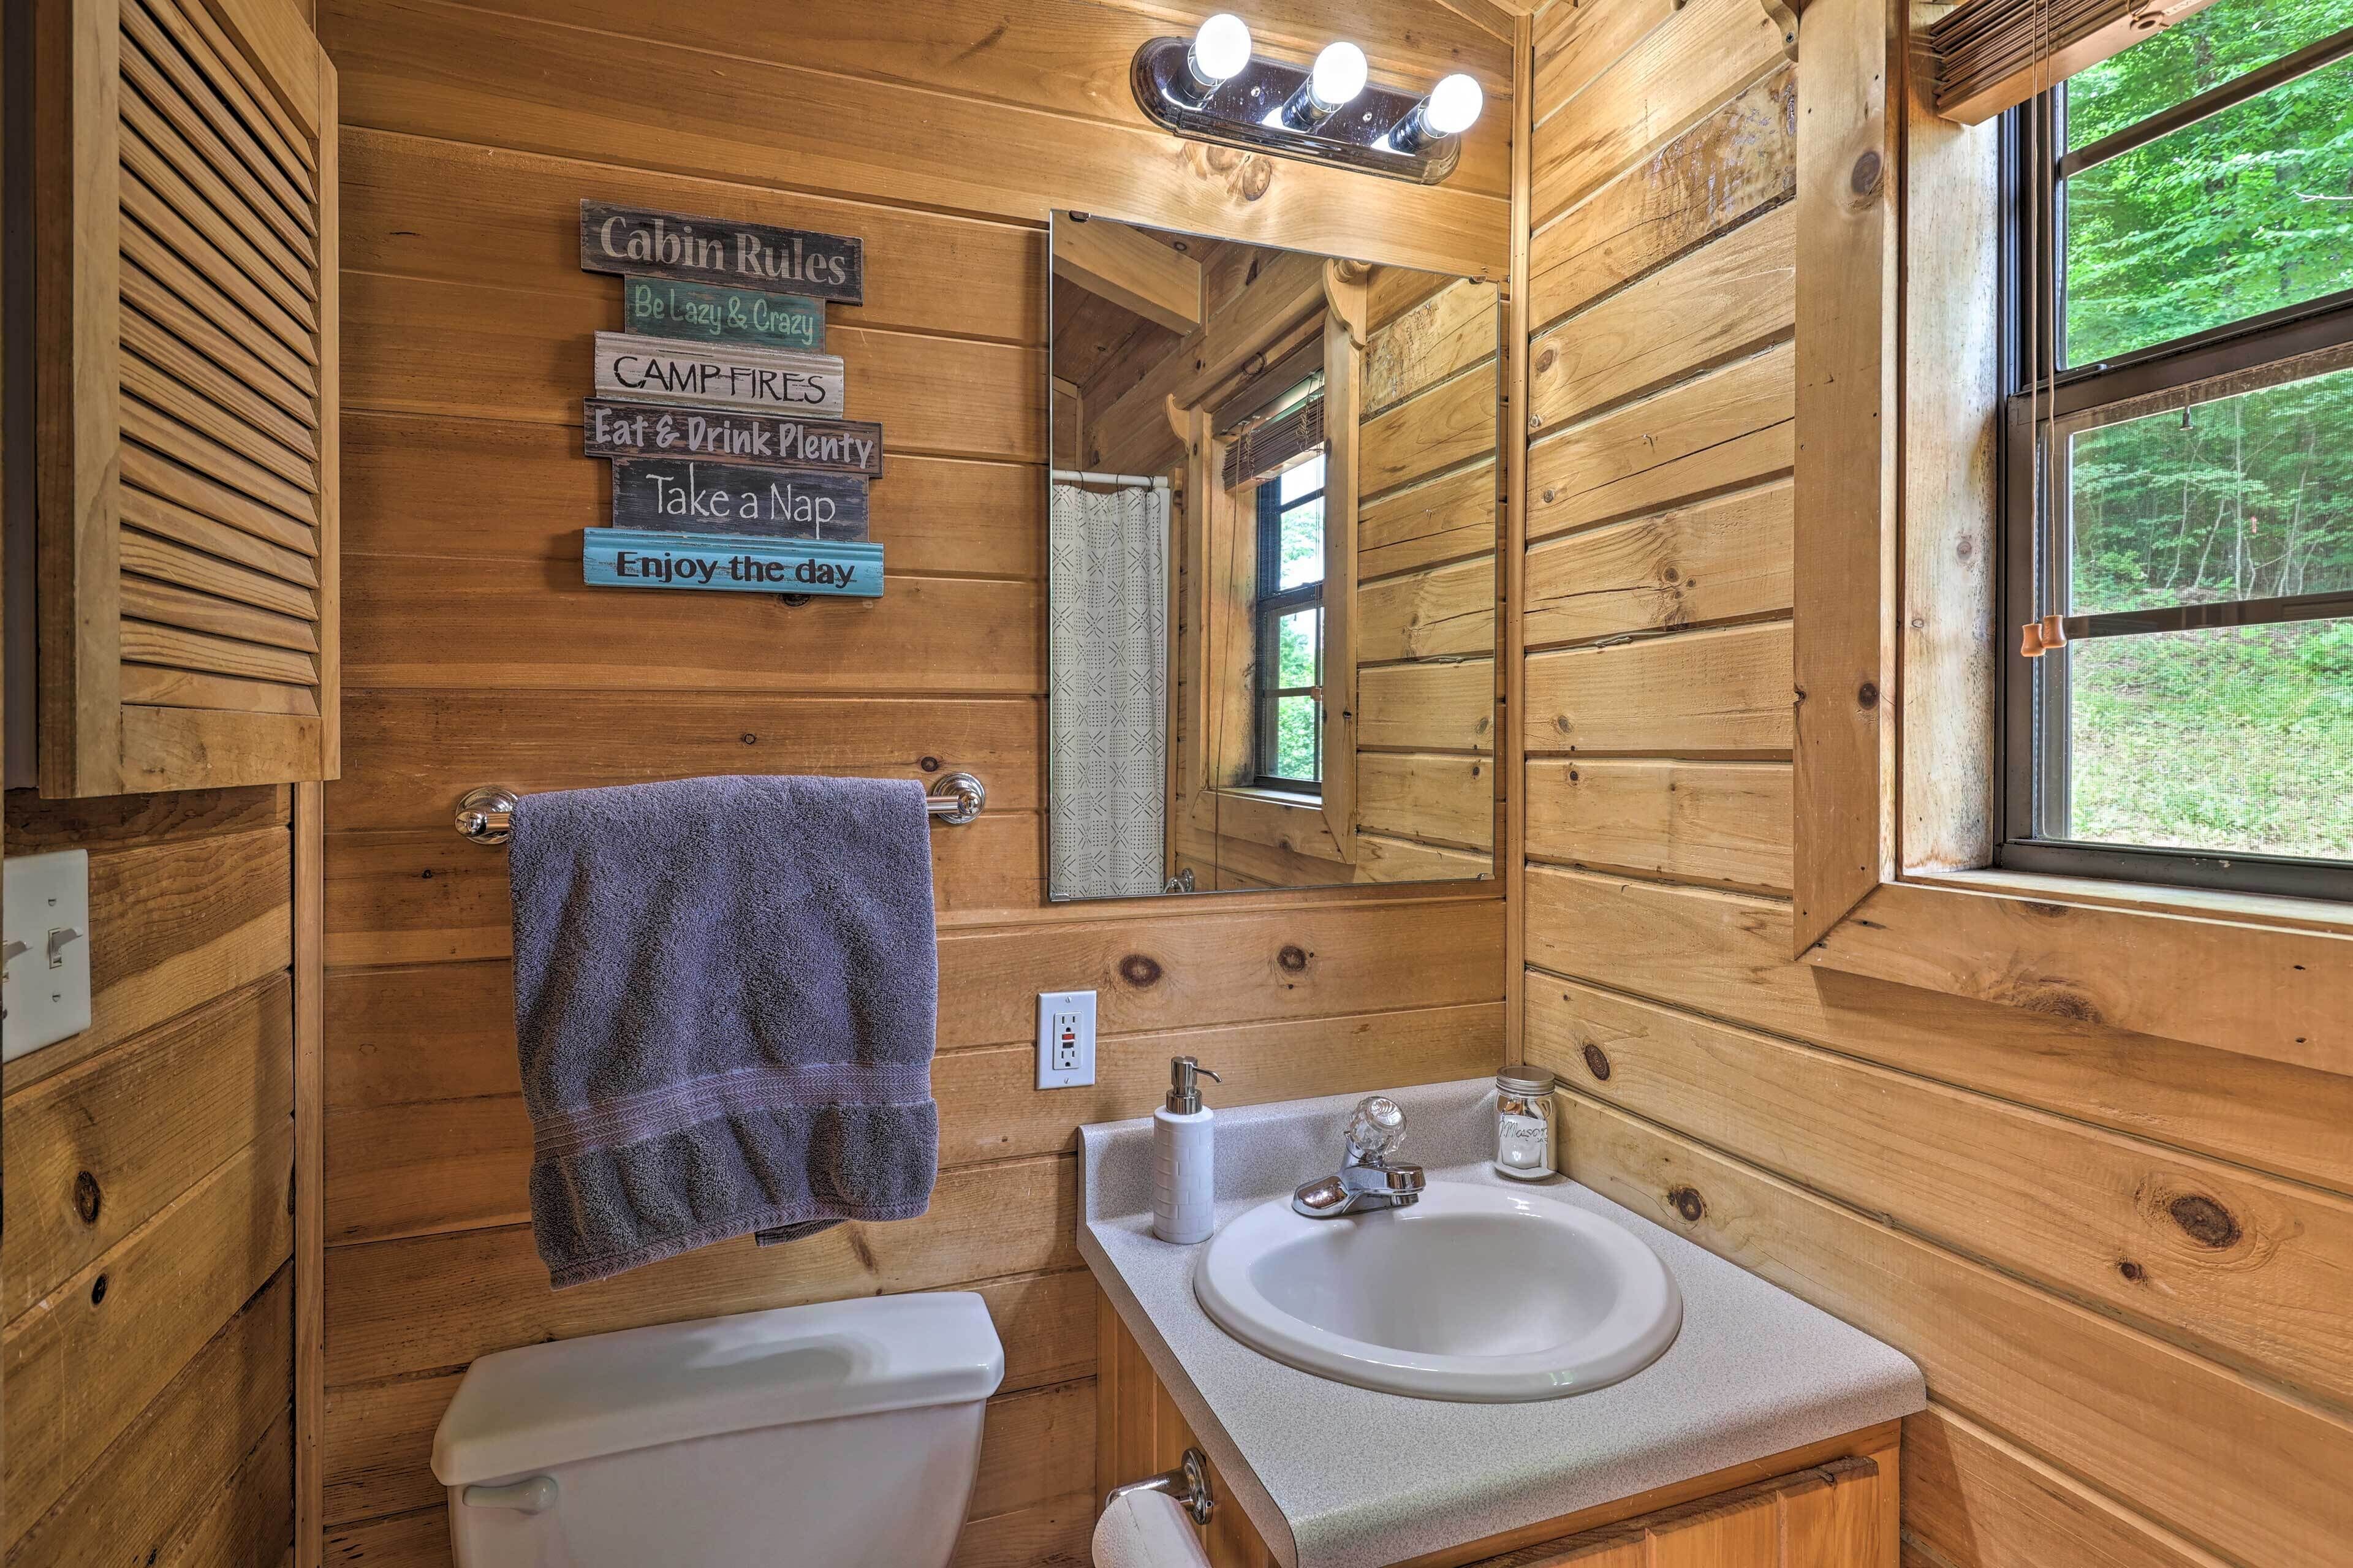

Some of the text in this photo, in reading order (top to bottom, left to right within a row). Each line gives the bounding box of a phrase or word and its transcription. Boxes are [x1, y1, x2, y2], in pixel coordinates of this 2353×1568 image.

[601, 216, 846, 285] Cabin Rules
[635, 284, 813, 346] Be Lazy & Crazy
[595, 409, 873, 469] Eat & Drink Plenty
[646, 463, 836, 540] Take a Nap
[616, 551, 856, 588] Enjoy the day
